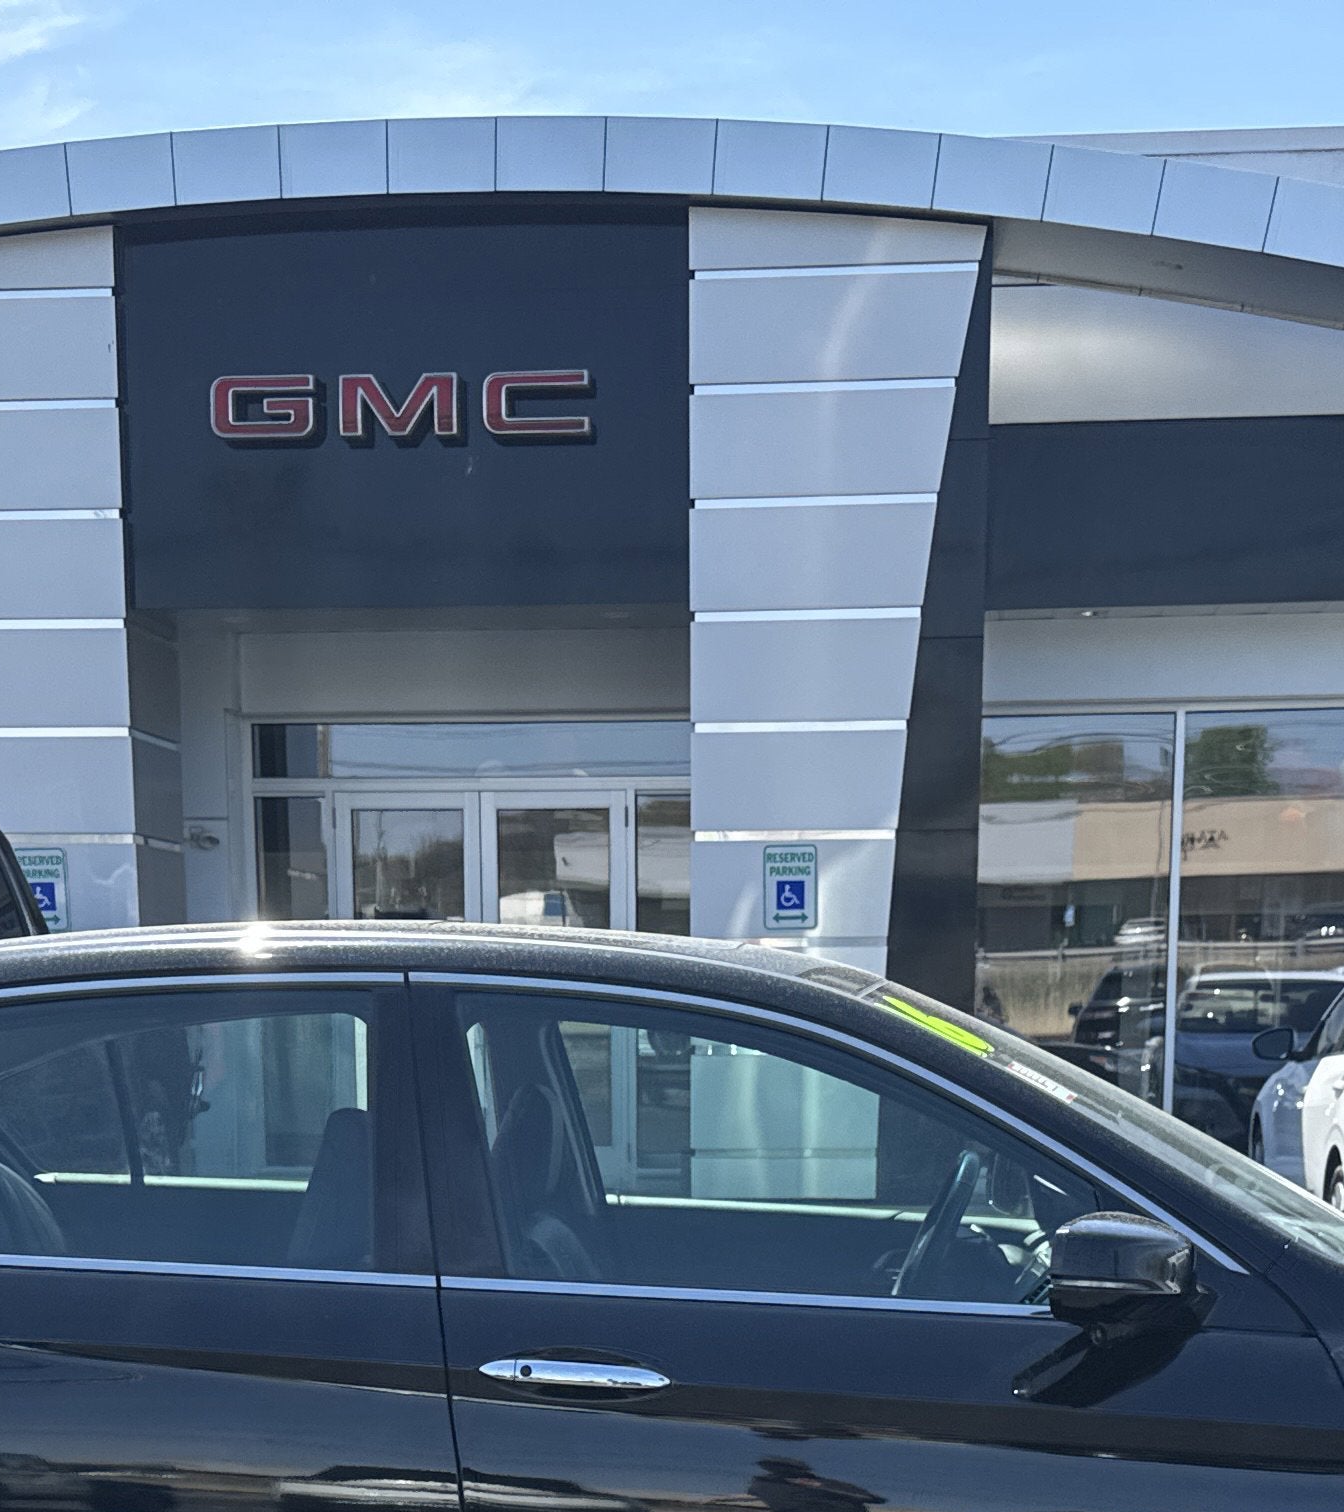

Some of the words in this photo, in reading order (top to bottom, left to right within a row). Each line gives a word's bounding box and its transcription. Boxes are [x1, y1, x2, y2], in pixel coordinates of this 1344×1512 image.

[209, 369, 594, 443] GMC
[766, 852, 815, 863] RESERVED
[769, 865, 811, 876] PARKING
